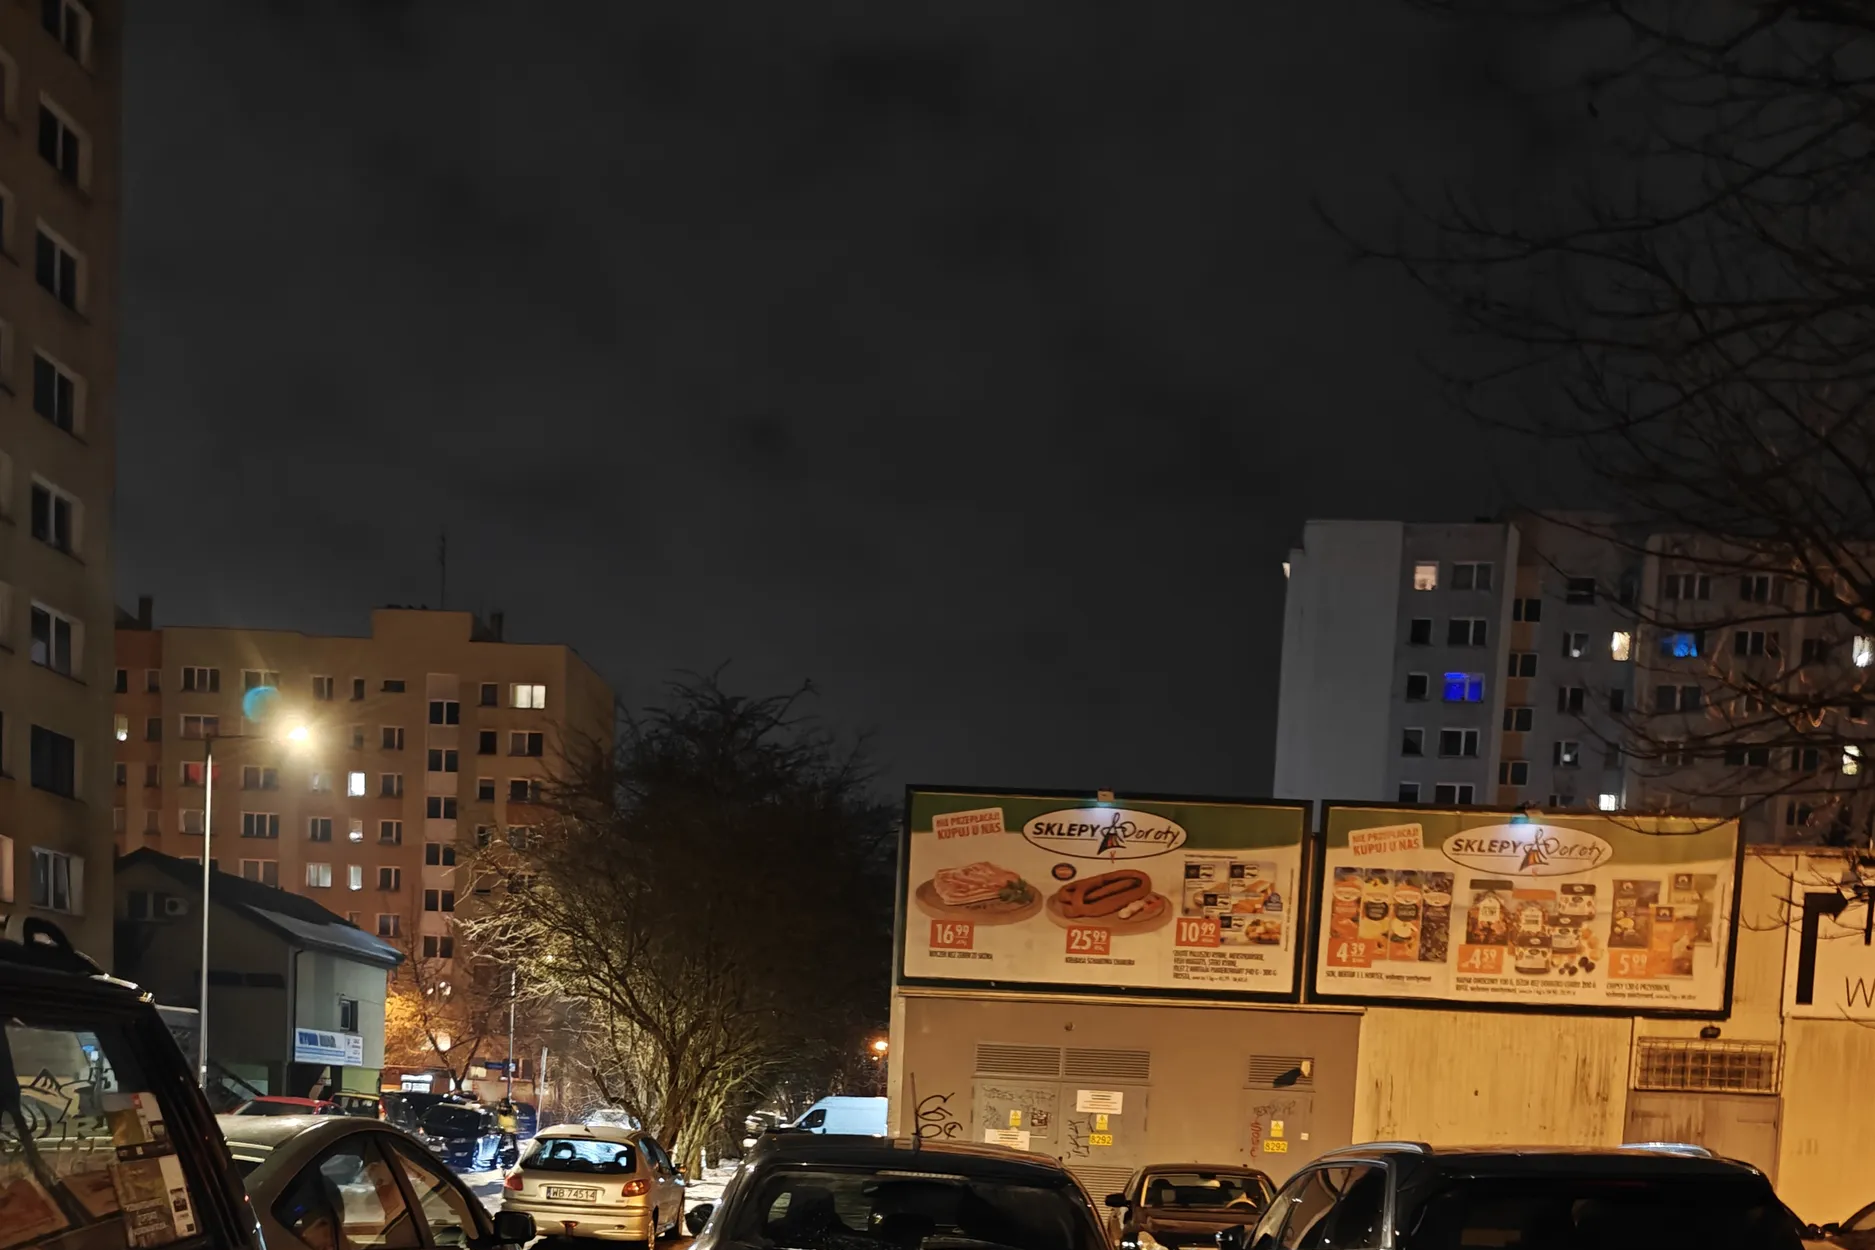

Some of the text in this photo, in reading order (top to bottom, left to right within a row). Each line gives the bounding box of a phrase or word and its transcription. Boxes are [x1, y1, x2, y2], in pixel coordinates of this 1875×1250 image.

[937, 822, 1002, 840] KUPUJ U NAS
[1032, 822, 1100, 837] SKLEPY
[1353, 838, 1420, 857] KUPUJ U NAS
[1452, 838, 1521, 854] SKLEPY
[1090, 1135, 1112, 1145] 8292
[1264, 1142, 1287, 1152] 8292
